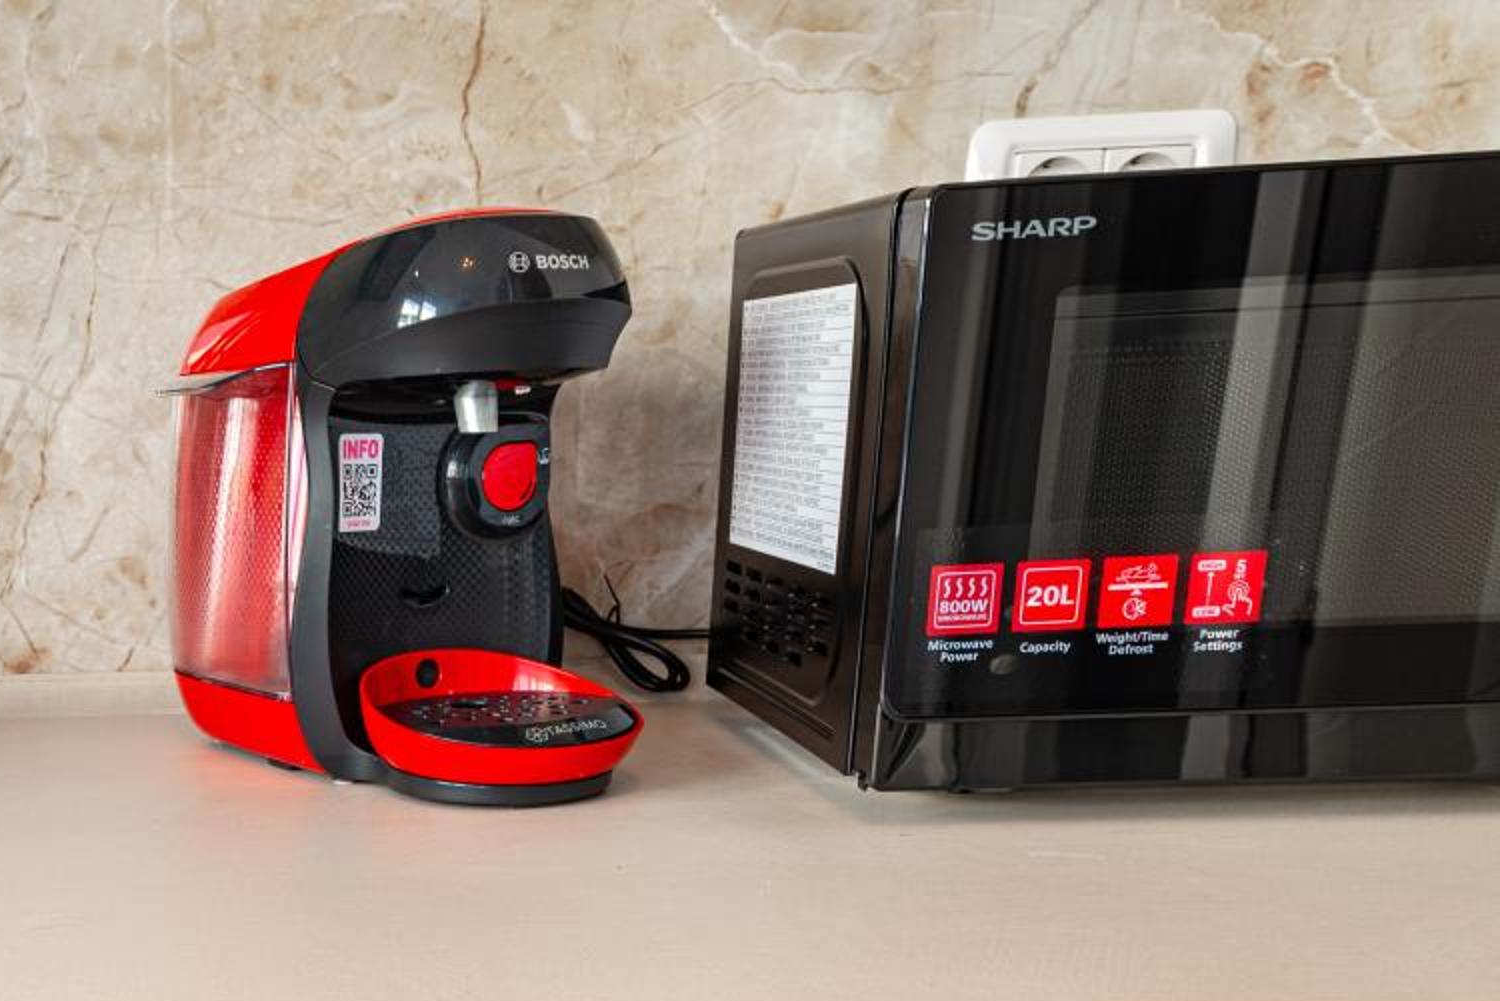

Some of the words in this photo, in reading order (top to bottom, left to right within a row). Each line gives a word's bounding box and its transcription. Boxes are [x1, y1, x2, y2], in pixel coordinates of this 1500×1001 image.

[971, 215, 1097, 241] SHARP
[535, 253, 590, 270] BOSCH
[343, 438, 379, 459] INFO
[1026, 583, 1075, 608] 20L
[939, 598, 989, 614] 800W
[1095, 630, 1170, 645] Weight/Time
[1199, 628, 1241, 640] Power
[927, 639, 994, 652] Microwave
[1019, 640, 1071, 655] Capacity
[1107, 643, 1155, 656] Defrost
[1192, 640, 1244, 653] Settings
[939, 651, 979, 663] Power
